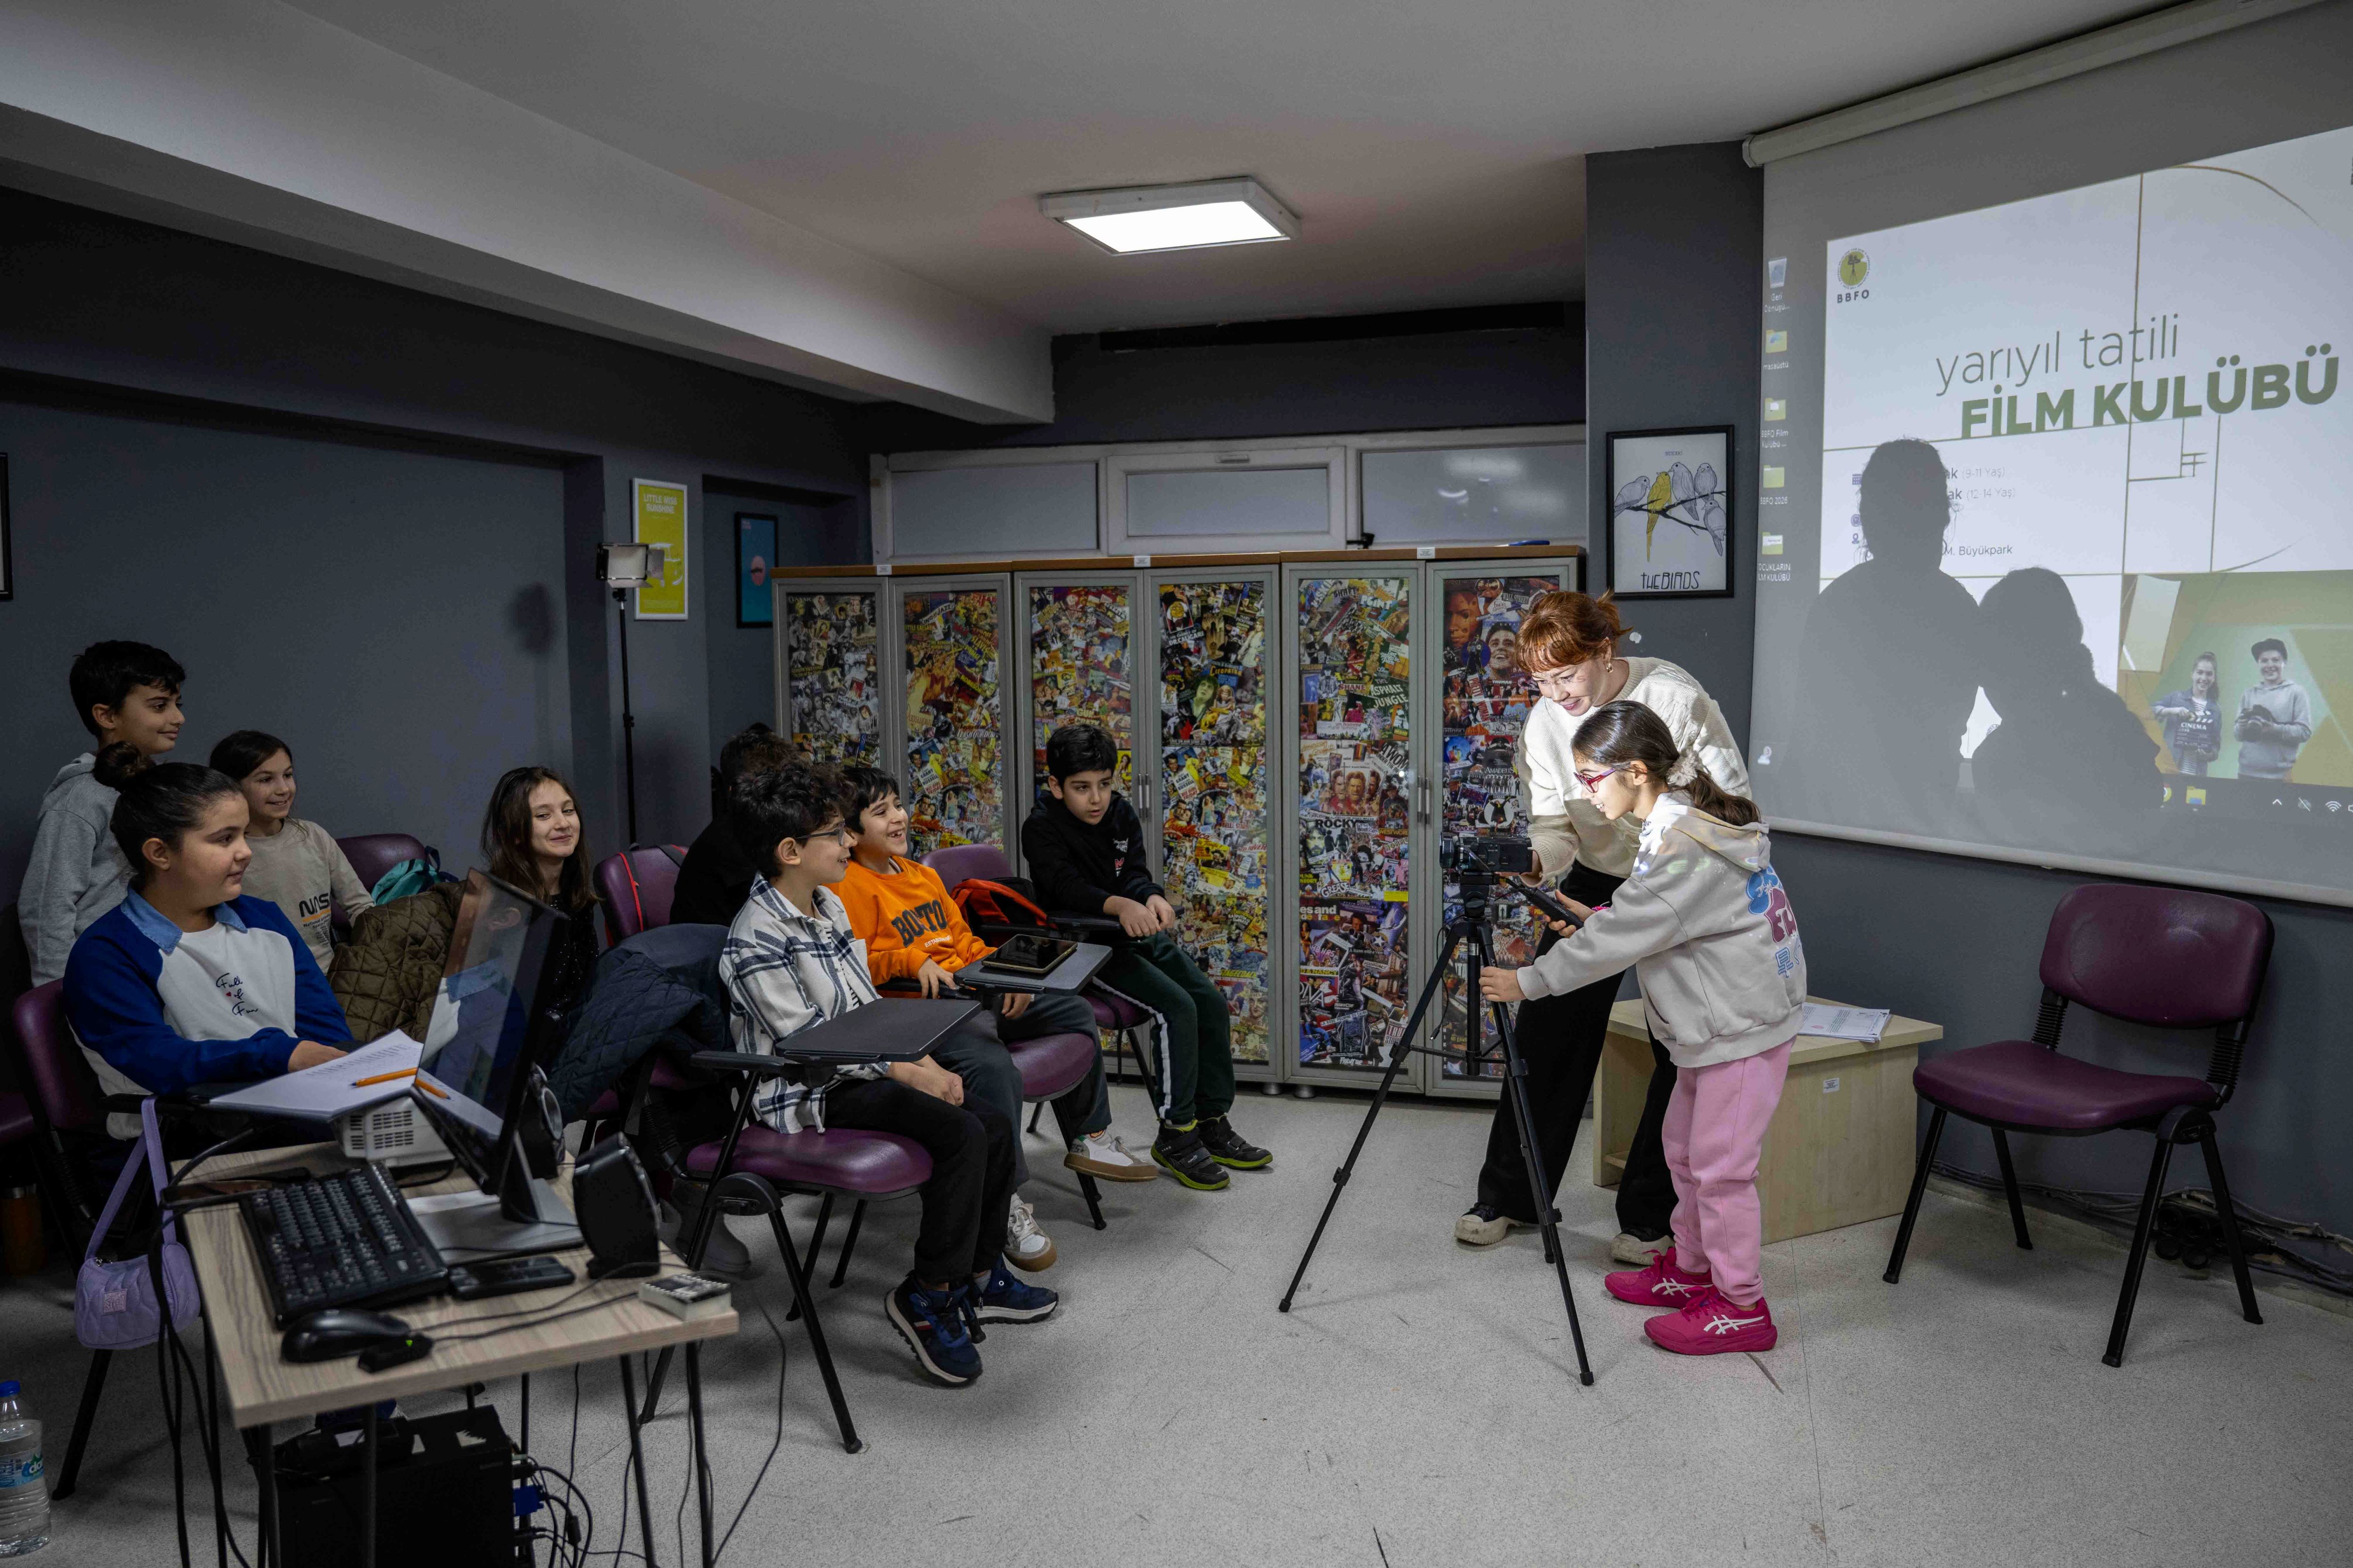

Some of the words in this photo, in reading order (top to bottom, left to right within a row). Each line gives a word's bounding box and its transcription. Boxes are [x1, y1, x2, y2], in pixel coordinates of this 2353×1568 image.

[1837, 289, 1869, 303] BBFO
[1936, 330, 2060, 396] yarıyıl
[2079, 313, 2178, 369] tatili
[1961, 384, 2075, 439] FİLM
[2092, 343, 2340, 427] KULÜBÜ
[643, 493, 662, 503] LITTLE
[664, 496, 677, 505] MISS
[1948, 488, 1962, 500] ak
[647, 503, 675, 514] SUNSHINE
[1959, 545, 2013, 557] Büyükpark
[1502, 593, 1513, 601] WALL
[1514, 595, 1529, 604] STREET
[1374, 694, 1408, 708] JUNGLE
[2181, 722, 2207, 731] CINEMA
[1315, 818, 1357, 828] ROCKY
[1321, 881, 1349, 896] GREASE
[299, 893, 329, 917] NAS
[1314, 905, 1336, 914] and
[216, 973, 243, 988] Full
[232, 1001, 258, 1016] Fun
